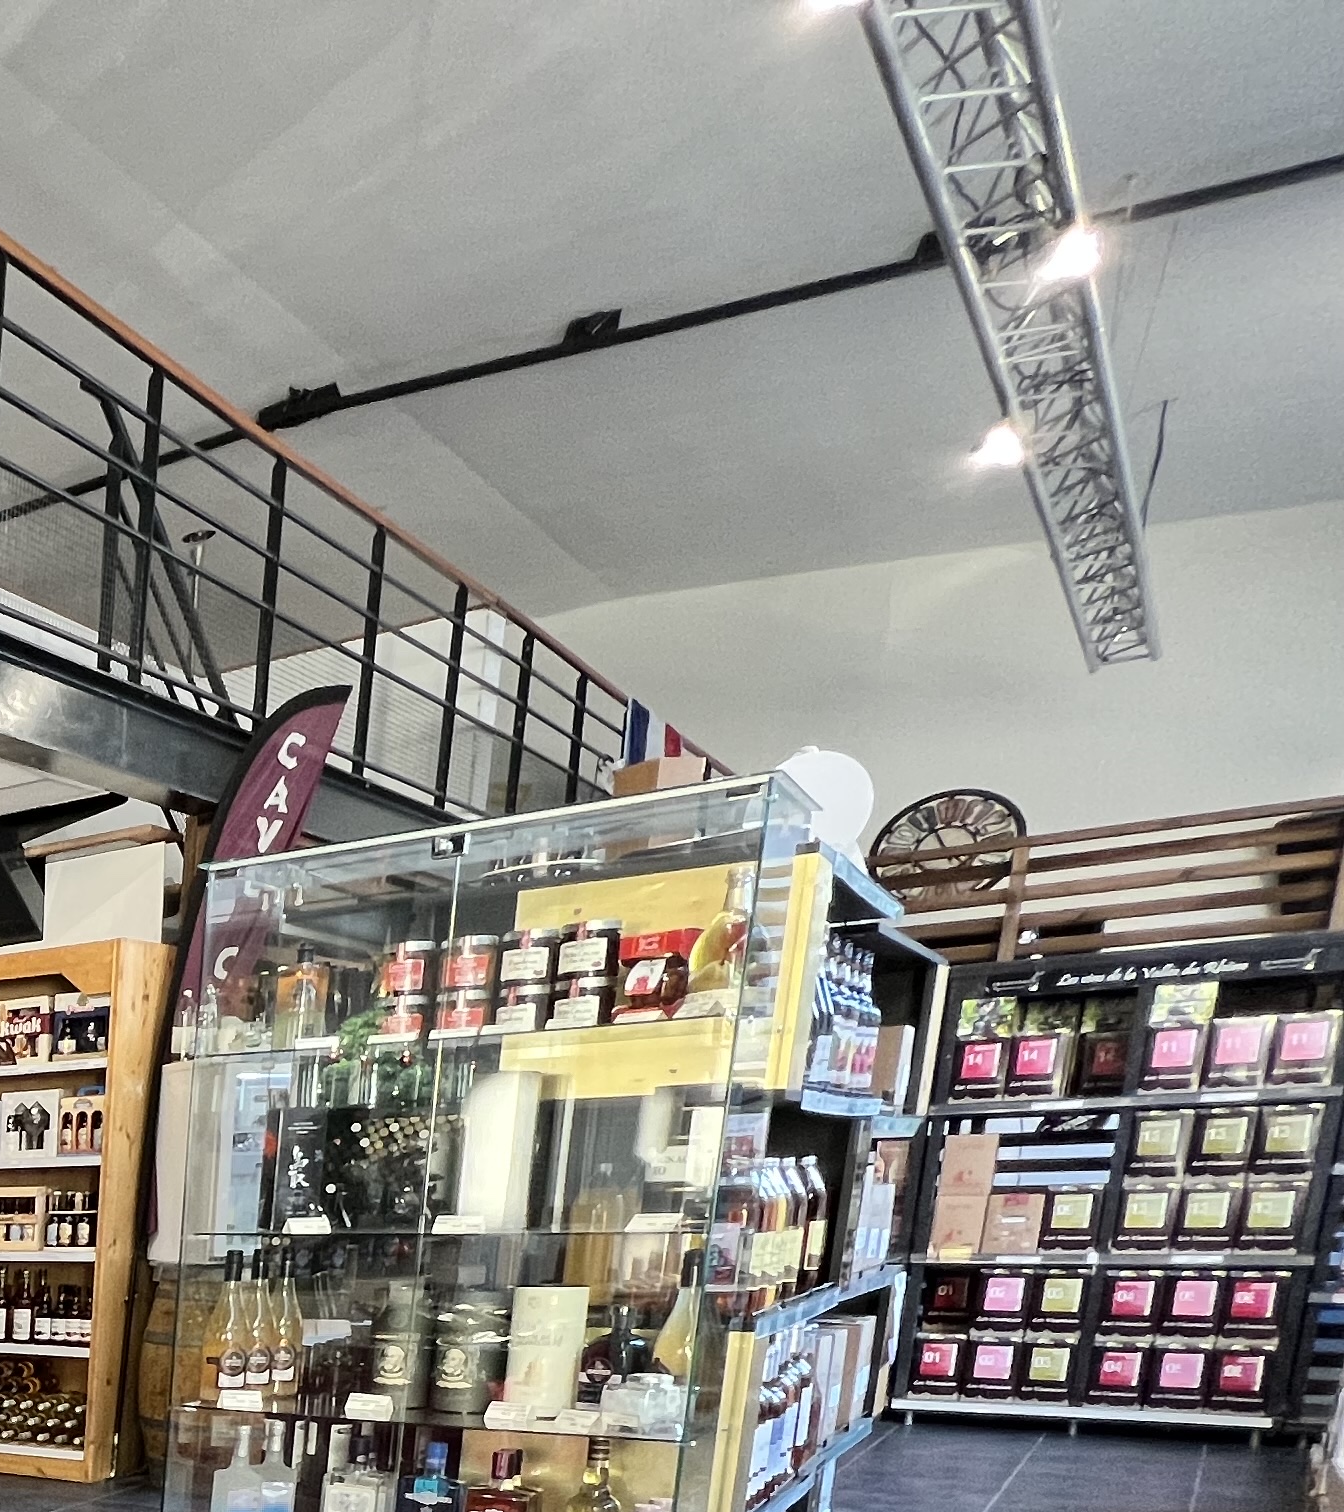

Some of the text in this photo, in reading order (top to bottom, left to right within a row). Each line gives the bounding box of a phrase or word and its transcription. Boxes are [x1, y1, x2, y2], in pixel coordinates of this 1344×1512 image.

[967, 1053, 983, 1066] 14
[1022, 1050, 1038, 1061] 14
[938, 1285, 953, 1296] 01
[923, 1351, 940, 1363] 01
